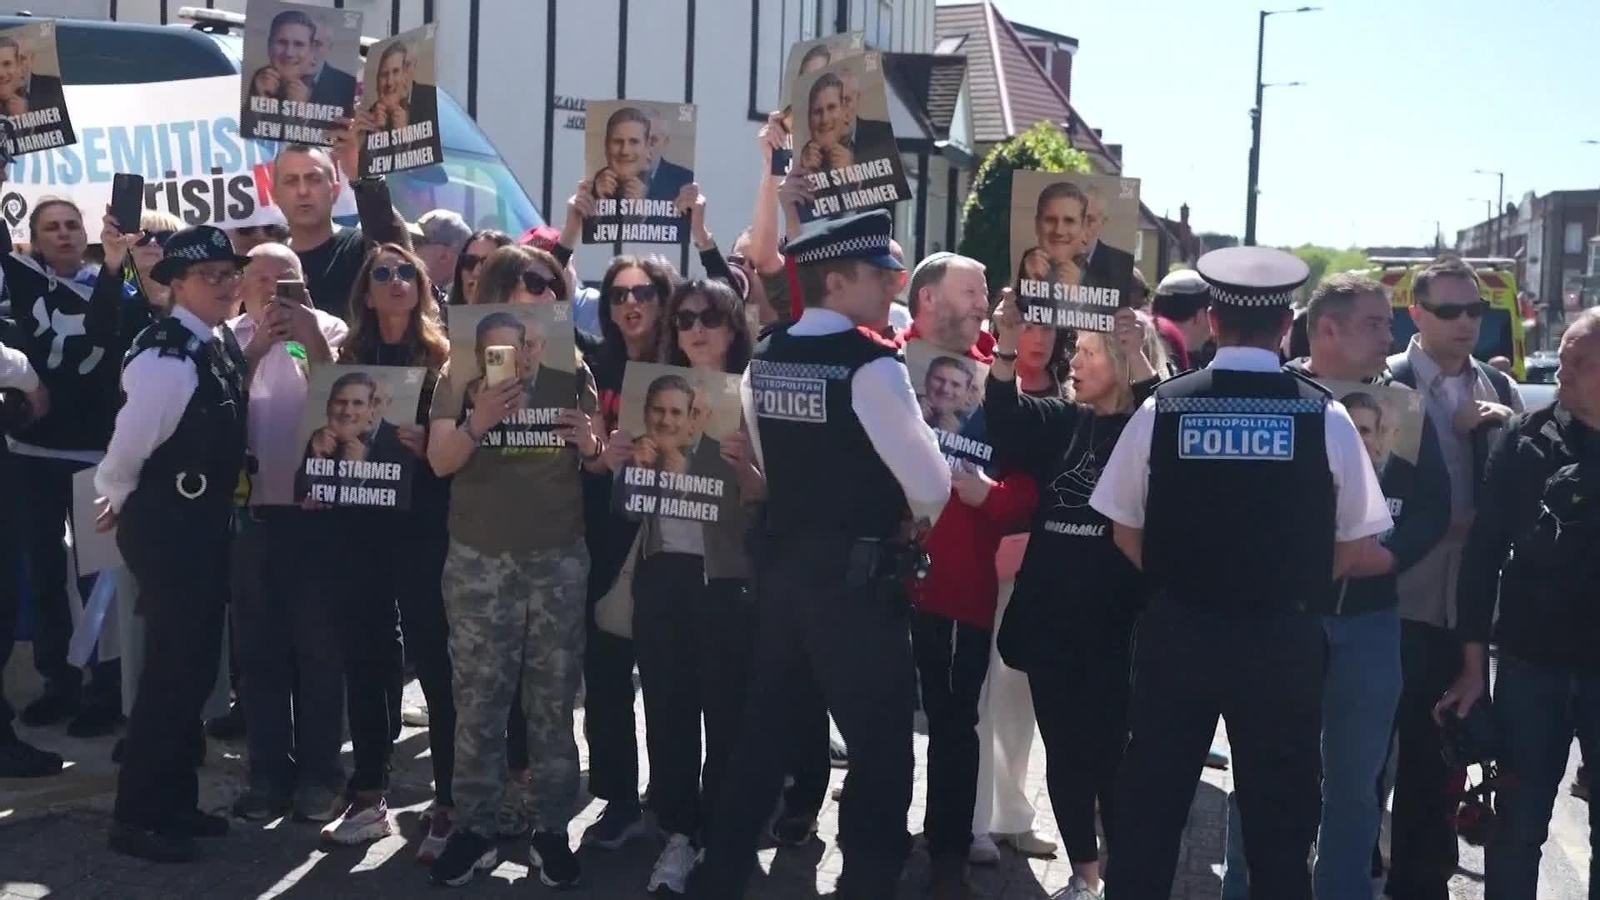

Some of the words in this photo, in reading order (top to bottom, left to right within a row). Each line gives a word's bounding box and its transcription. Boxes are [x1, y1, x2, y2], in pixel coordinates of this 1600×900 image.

[250, 96, 279, 114] KEIR
[281, 100, 344, 121] STARMER
[19, 130, 64, 154] HARMER
[253, 121, 281, 138] JEW
[284, 124, 334, 144] HARM
[367, 131, 389, 150] KEIR
[391, 120, 433, 146] STARMER
[368, 155, 392, 173] JEW
[395, 146, 433, 169] HARMER
[804, 172, 830, 192] EIR
[830, 158, 893, 186] STARMER
[595, 200, 617, 216] EIR
[811, 195, 840, 217] JEW
[841, 184, 898, 210] HARMER
[593, 224, 618, 241] JEW
[621, 224, 678, 241] HARMER
[1020, 279, 1049, 298] KEIR
[1053, 283, 1120, 307] STARMER
[1024, 305, 1053, 323] JEW
[1057, 309, 1115, 332] HARMER
[754, 389, 822, 417] POLICE
[502, 408, 564, 425] TARME
[1184, 418, 1290, 428] METROPOLITAN
[1183, 429, 1289, 455] POLICE
[306, 458, 334, 476] KEIR
[338, 460, 401, 480] STARMER
[624, 467, 655, 486] KEIR
[659, 470, 724, 496] STARMER
[307, 484, 336, 502] JEW
[340, 486, 396, 506] HARMER
[625, 494, 656, 514] JEW
[659, 498, 719, 521] HARMER
